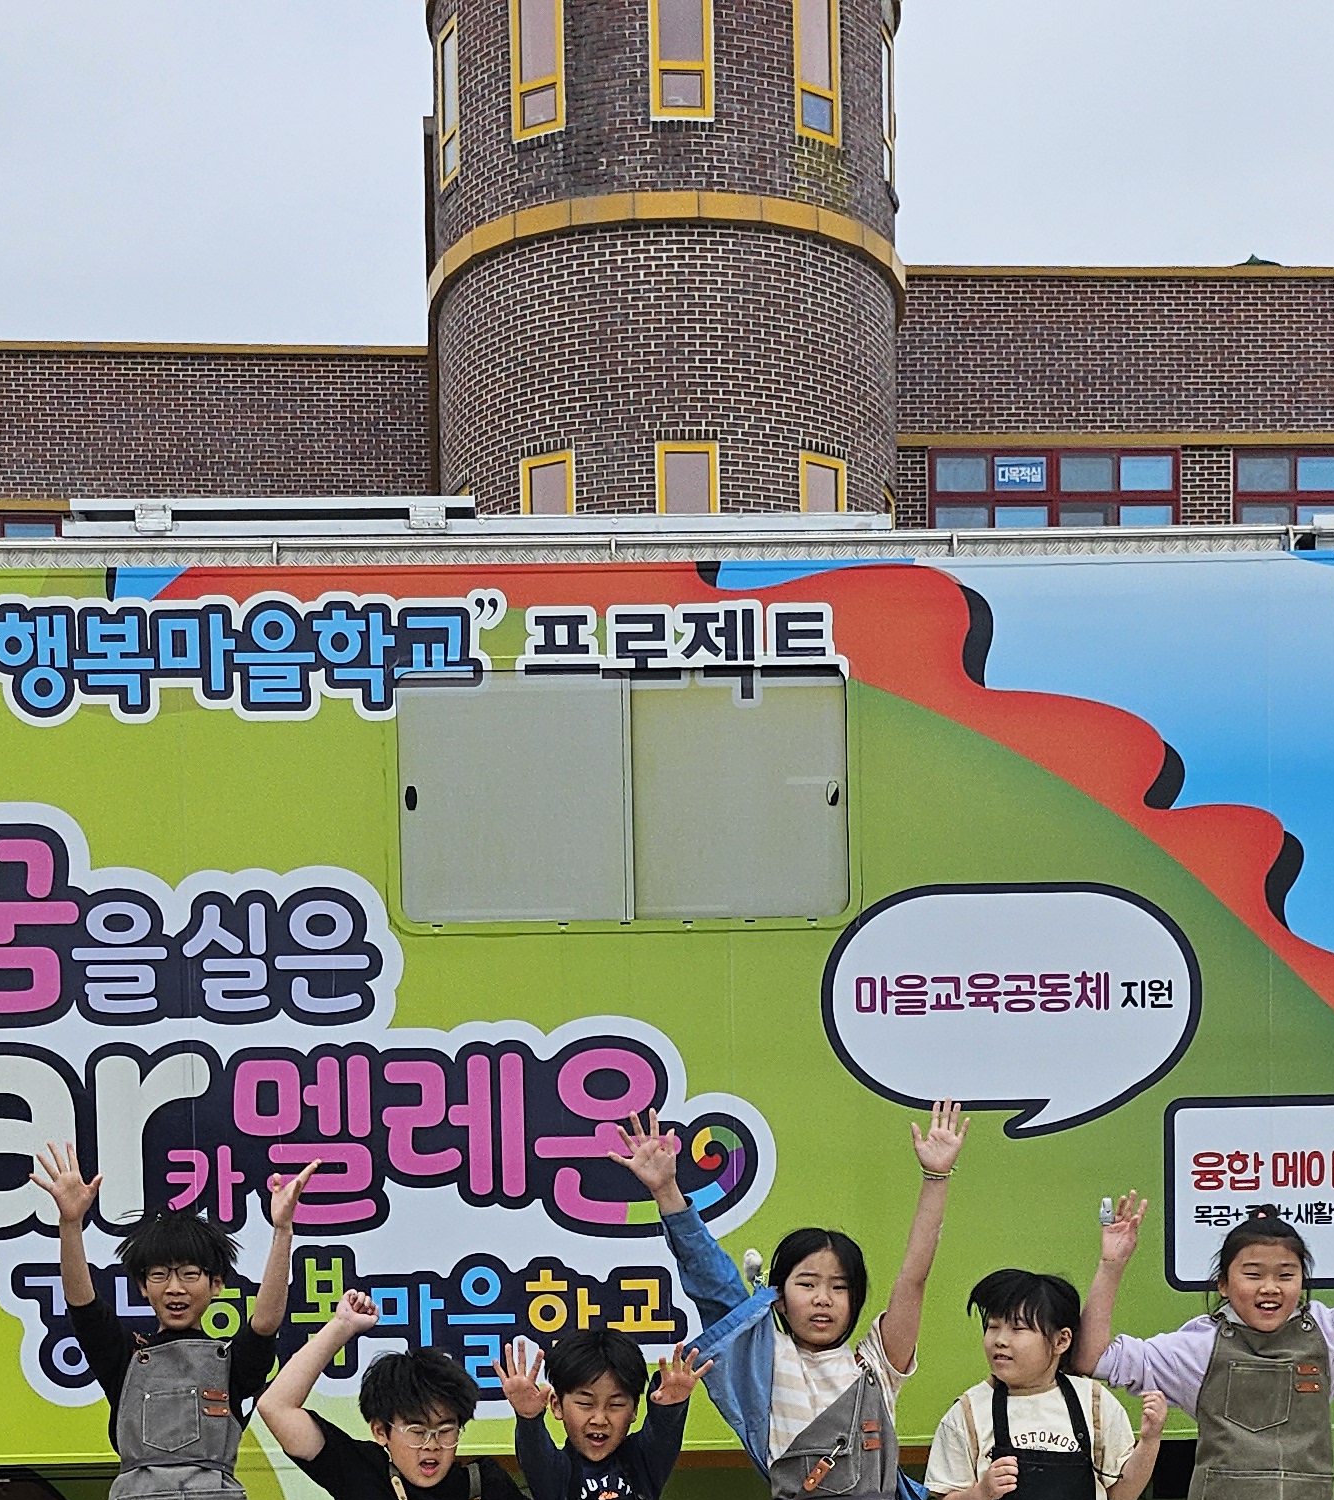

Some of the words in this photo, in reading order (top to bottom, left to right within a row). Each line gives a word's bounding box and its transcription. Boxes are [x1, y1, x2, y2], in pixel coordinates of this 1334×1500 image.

[998, 466, 1042, 483] 다목적실
[524, 608, 840, 700] 프로젝트
[182, 894, 370, 1013] 실은
[855, 971, 1110, 1015] 마을교육공동체
[1121, 980, 1173, 1009] 지원
[1190, 1151, 1265, 1191] 융합
